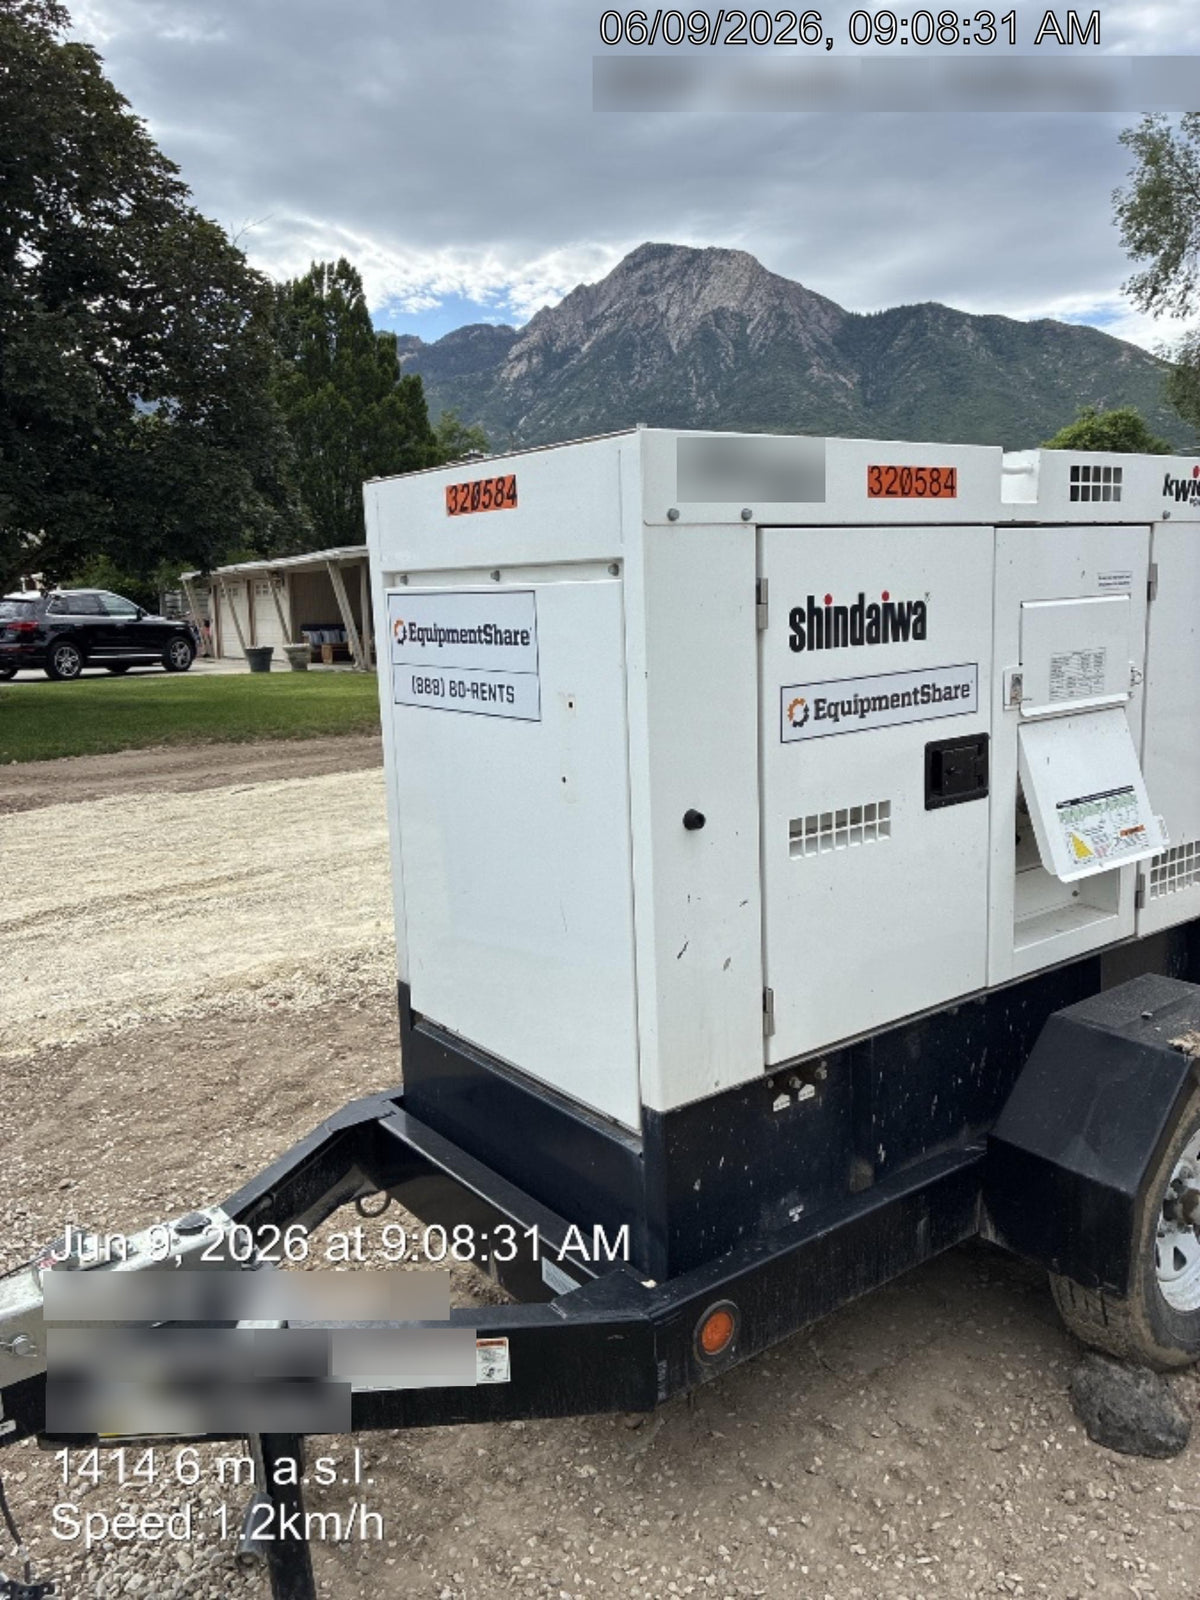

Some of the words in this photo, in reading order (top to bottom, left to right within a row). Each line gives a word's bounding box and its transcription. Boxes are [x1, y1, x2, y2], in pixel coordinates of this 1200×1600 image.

[446, 476, 518, 514] 320584
[869, 465, 956, 496] 320584
[407, 621, 530, 648] EquipmentShare
[788, 590, 927, 653] shindaiwa
[411, 675, 445, 697] (888)
[813, 682, 970, 722] EquipmentShare
